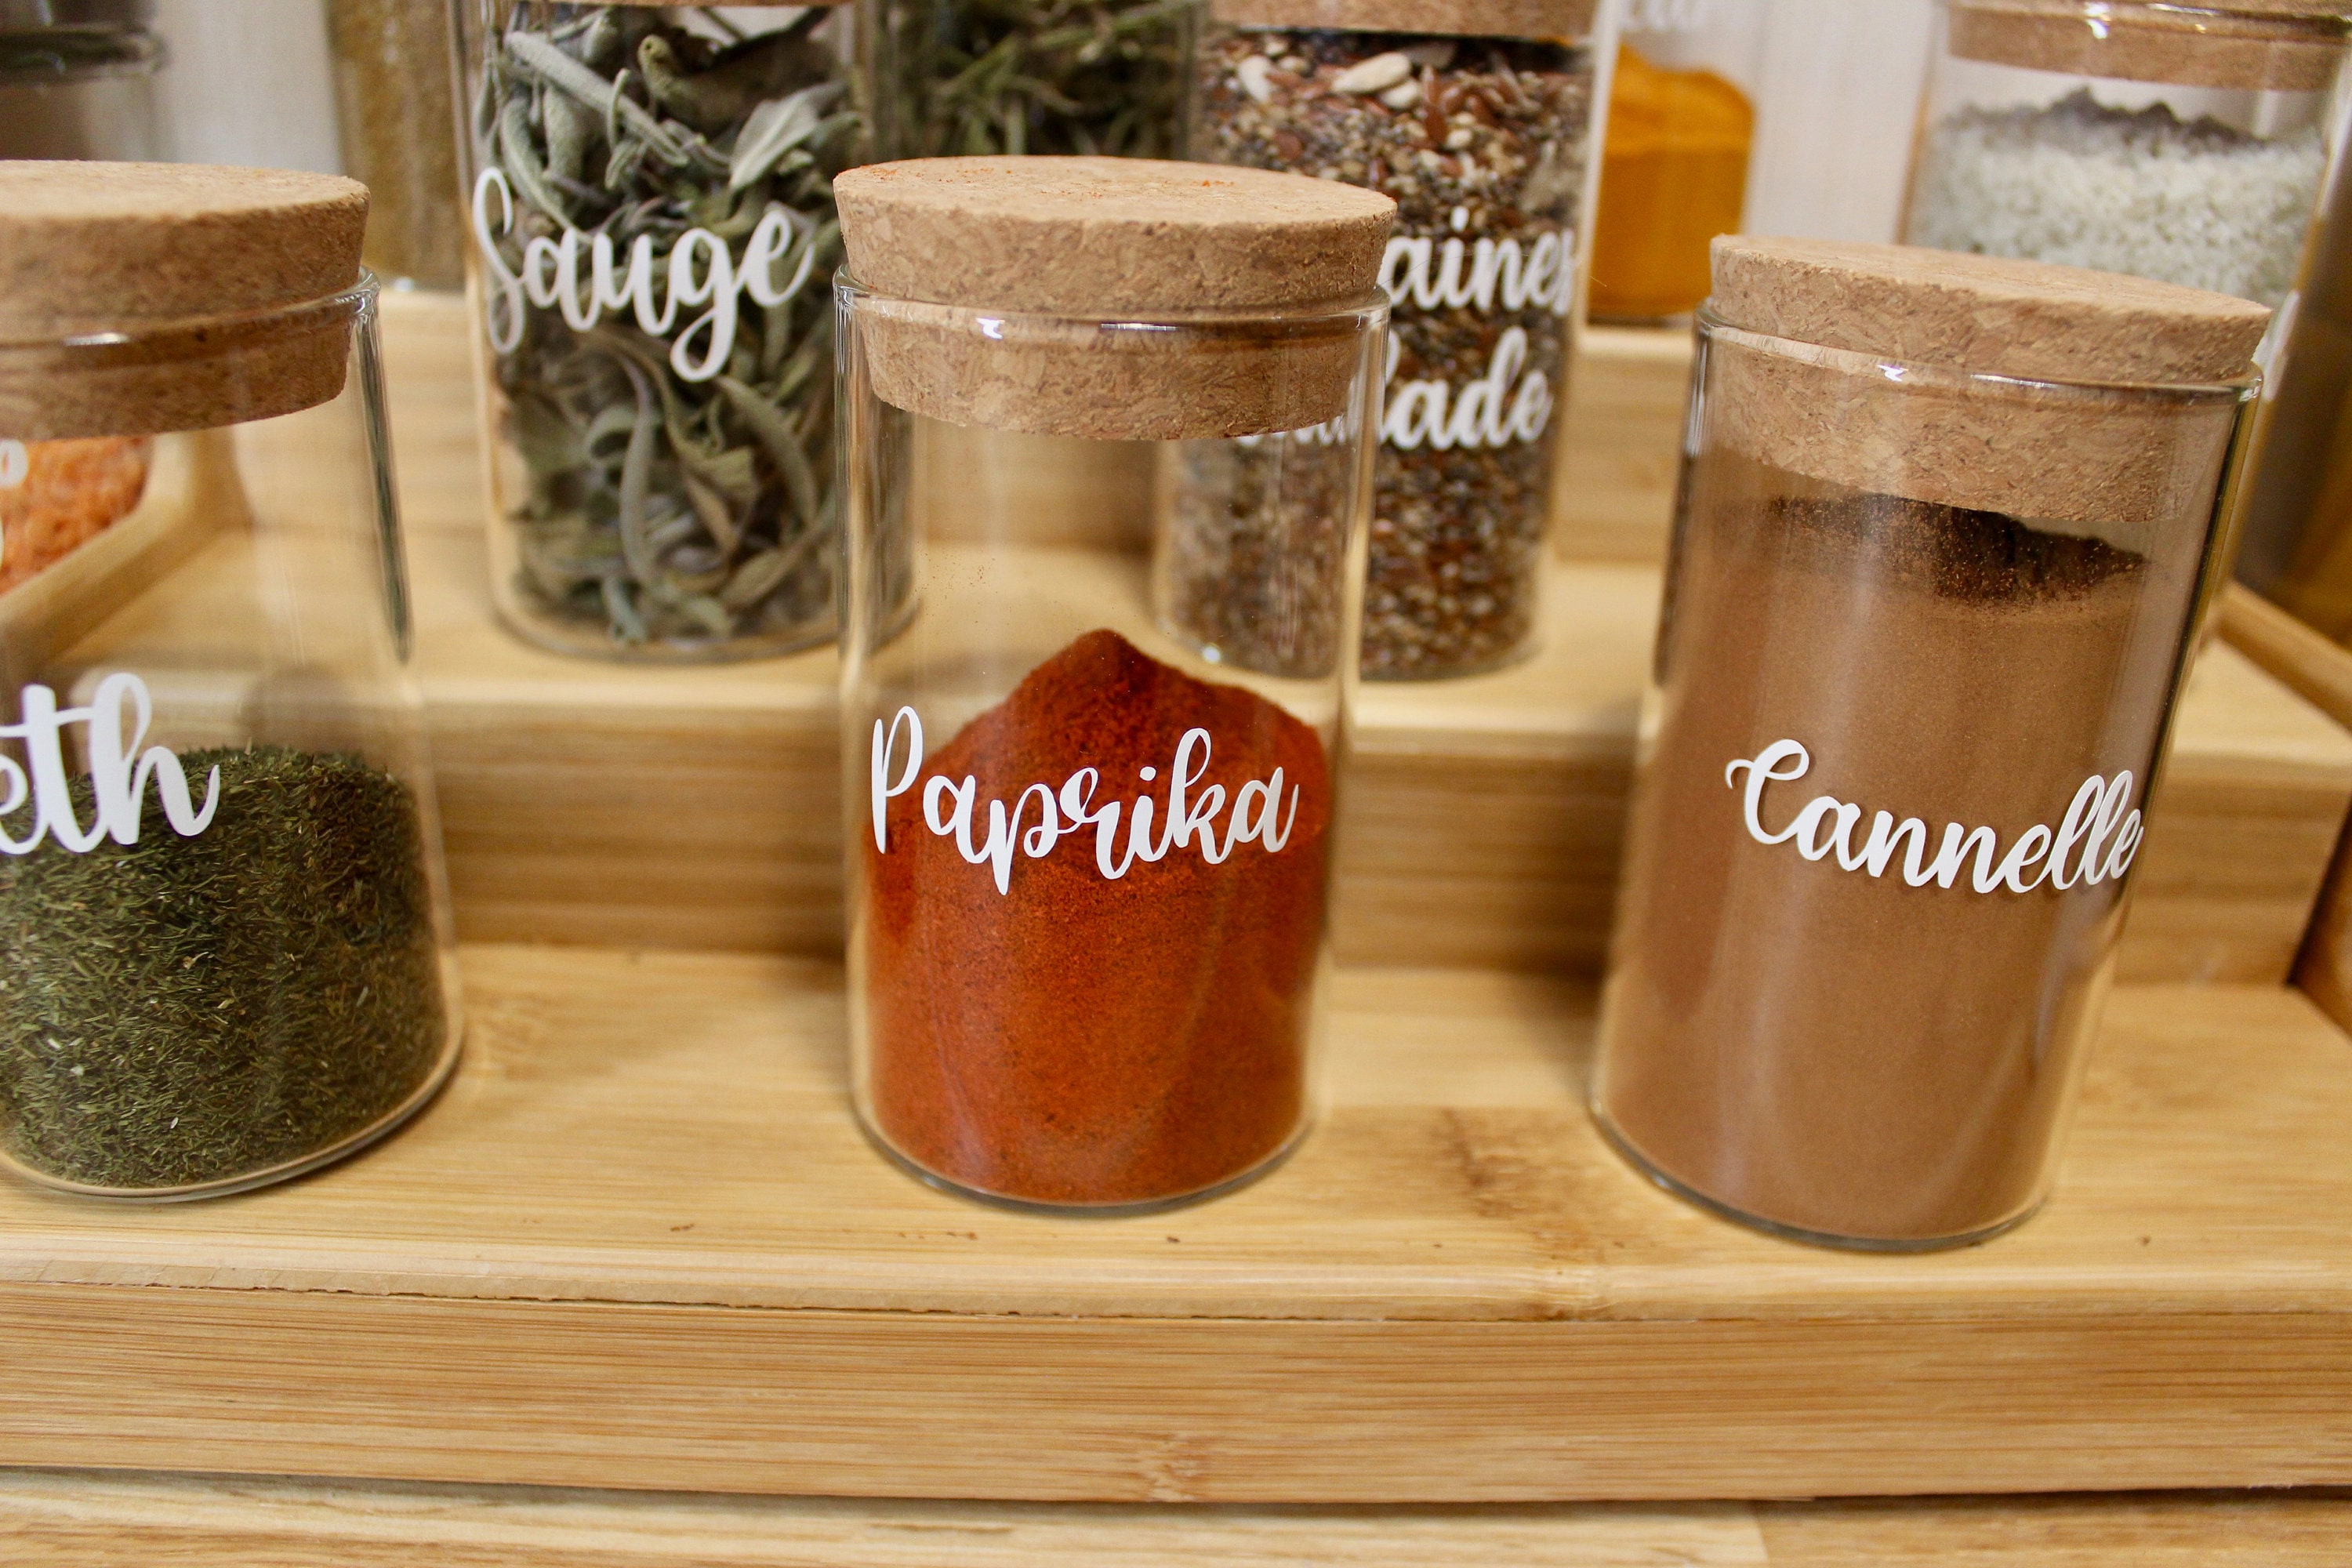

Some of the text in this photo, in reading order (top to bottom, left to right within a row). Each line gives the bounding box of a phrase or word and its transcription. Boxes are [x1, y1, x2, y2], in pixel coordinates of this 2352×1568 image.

[472, 167, 816, 383] Sauge
[1376, 205, 1582, 315] aines
[0, 672, 220, 855] eth
[871, 706, 1298, 896] Paprika
[1725, 739, 2144, 894] Cannelle
